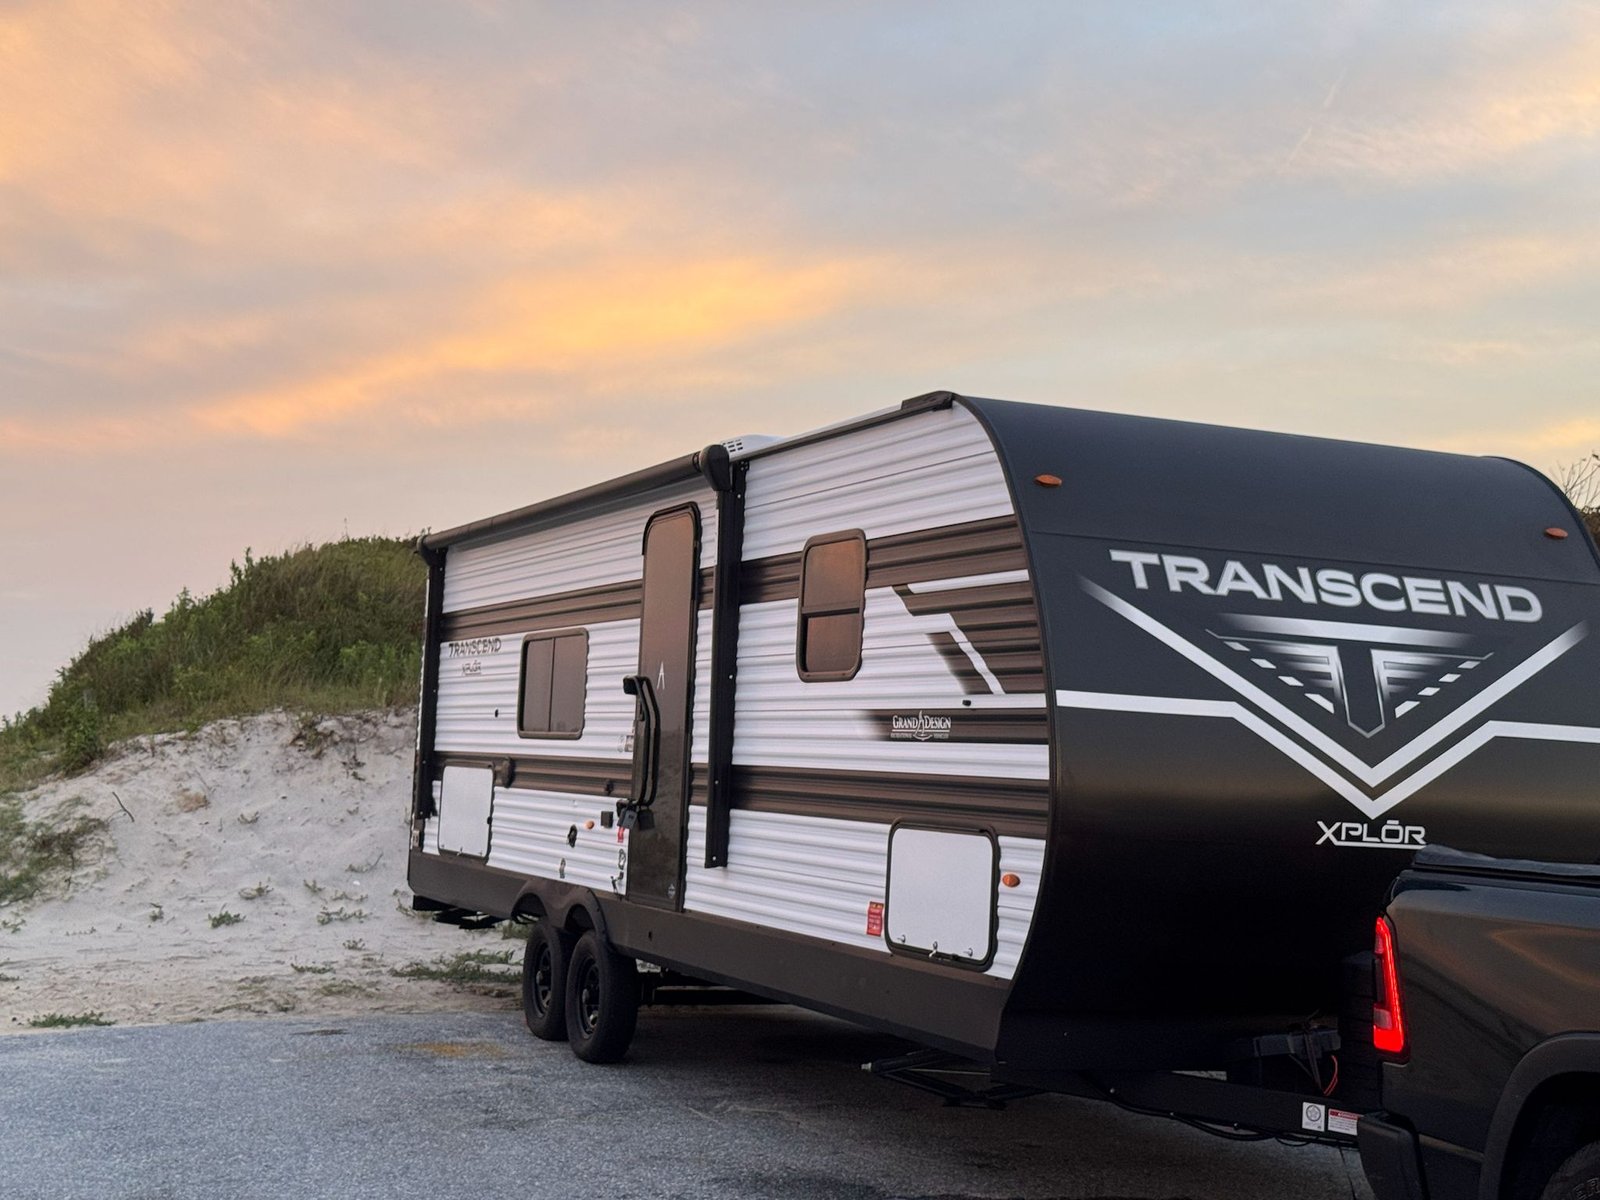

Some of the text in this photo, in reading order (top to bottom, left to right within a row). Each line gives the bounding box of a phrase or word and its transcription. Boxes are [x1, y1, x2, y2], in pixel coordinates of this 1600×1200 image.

[1109, 549, 1542, 623] TRANSCEND
[448, 637, 502, 658] TRANSCEND
[892, 715, 952, 729] GRAND DESIGN
